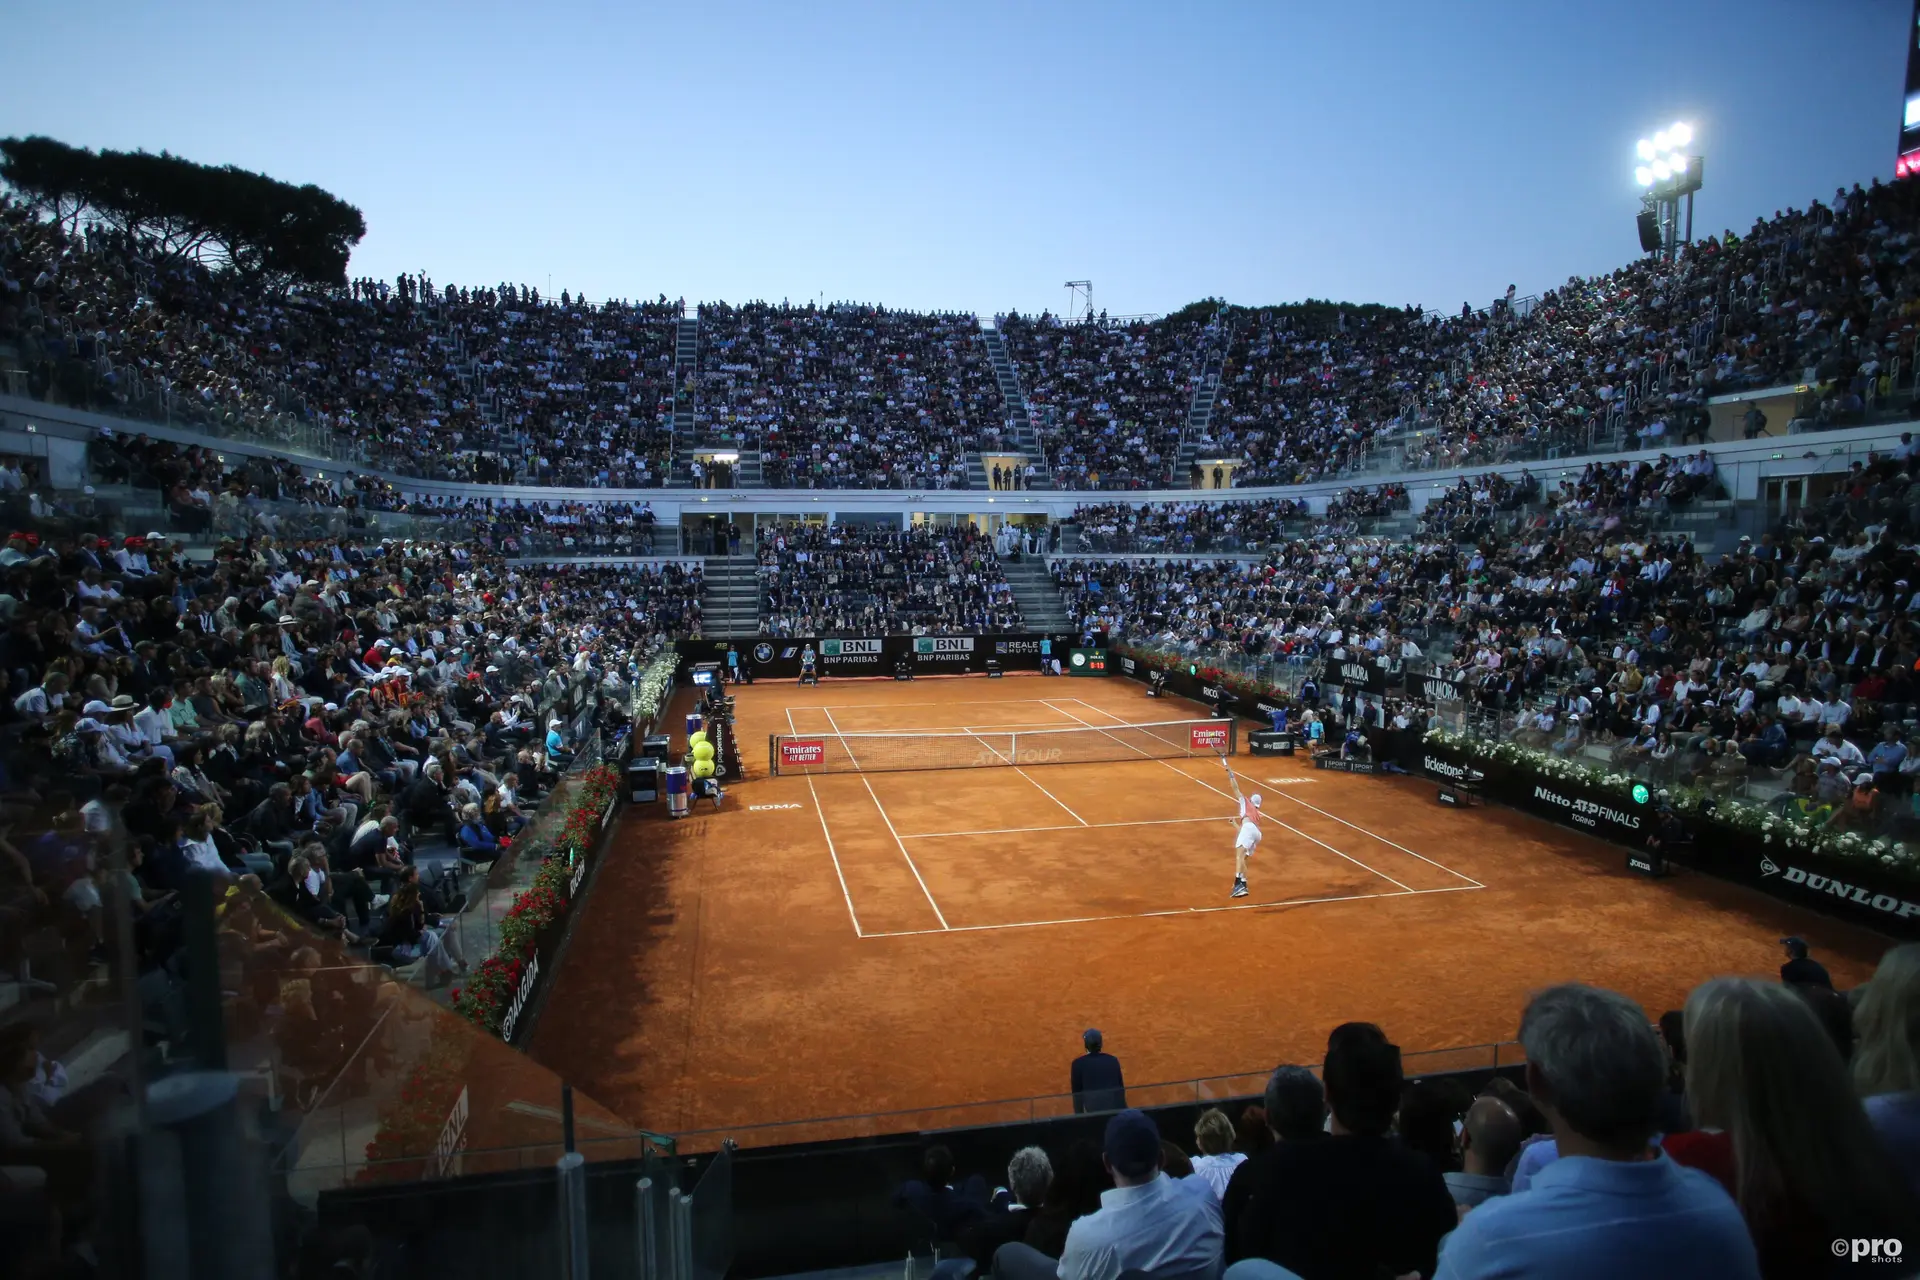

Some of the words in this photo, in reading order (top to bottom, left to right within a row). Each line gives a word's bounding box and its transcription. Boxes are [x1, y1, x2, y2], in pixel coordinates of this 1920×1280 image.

[842, 641, 877, 652] BNL
[935, 639, 970, 651] BNL
[1008, 641, 1039, 649] REALE
[823, 656, 841, 664] BNP
[842, 655, 878, 663] PARIBAS
[917, 654, 934, 662] BNP
[935, 653, 970, 661] PARIBAS
[1341, 663, 1369, 682] VALMORA
[1203, 686, 1219, 699] RICO
[1423, 680, 1459, 700] VALMORA
[716, 723, 724, 763] pepperstone
[783, 745, 822, 755] Emirates
[749, 803, 803, 811] ROMA
[1534, 785, 1571, 808] Nitto
[1571, 798, 1599, 815] ATP
[1597, 802, 1641, 829] FINALS
[1571, 813, 1596, 827] TORINO
[1782, 866, 1920, 918] DUNLOP
[512, 952, 540, 1025] ALGIDA
